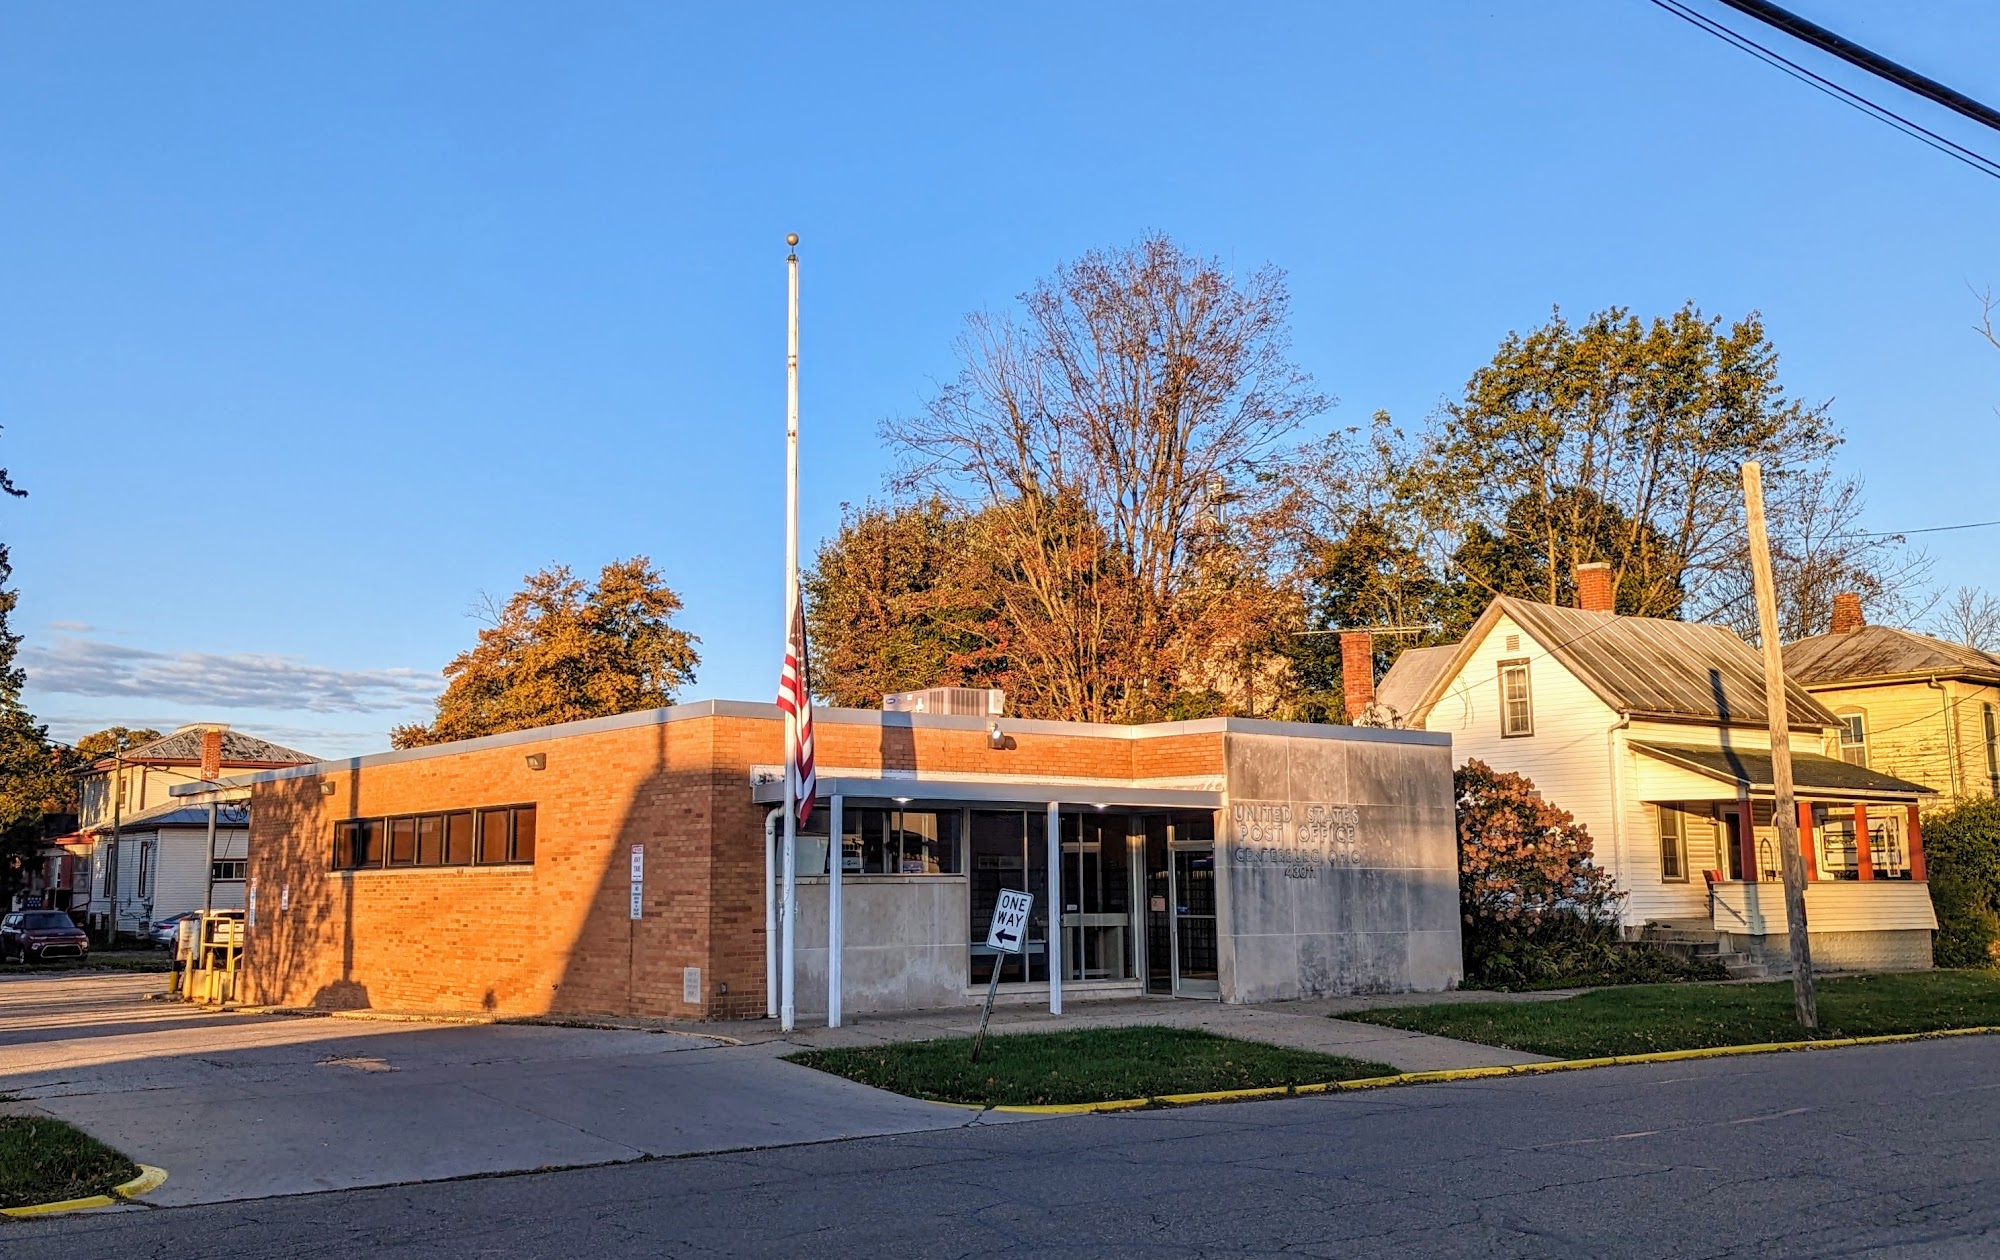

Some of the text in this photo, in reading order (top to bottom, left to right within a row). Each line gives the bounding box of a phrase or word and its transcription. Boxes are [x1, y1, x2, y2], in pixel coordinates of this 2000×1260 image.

[1233, 804, 1360, 825] UNITED STATES
[1239, 824, 1355, 843] POST OFFICE
[1002, 895, 1027, 912] ONE
[997, 910, 1023, 928] WAY
